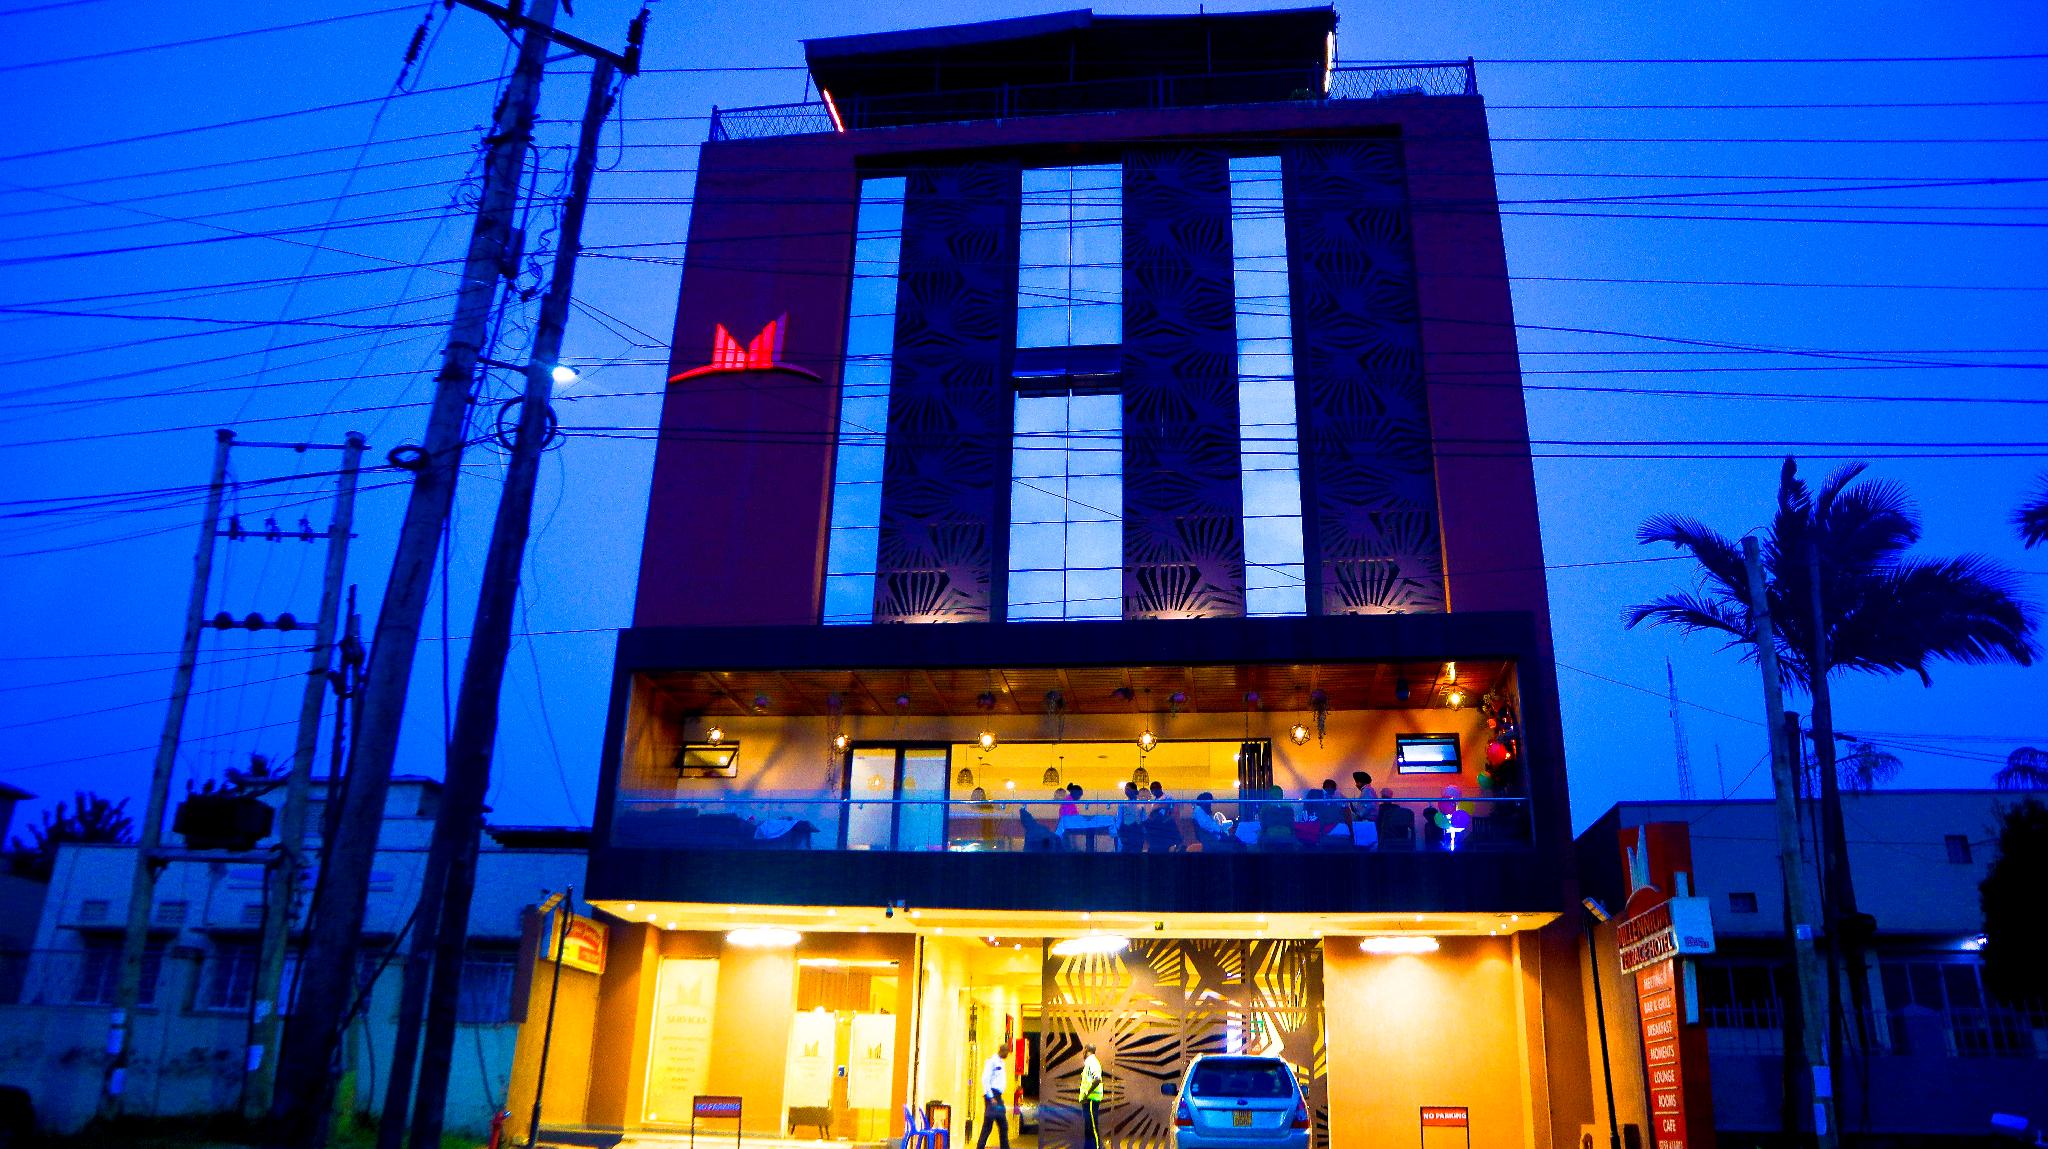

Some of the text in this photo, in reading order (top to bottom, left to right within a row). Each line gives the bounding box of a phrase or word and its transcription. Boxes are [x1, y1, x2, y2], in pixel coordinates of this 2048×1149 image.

[1617, 911, 1670, 948] MILLENNIUM
[1648, 931, 1673, 958] HOTEL
[1643, 1000, 1653, 1014] BAR
[1658, 996, 1672, 1011] GRILL
[1647, 1020, 1672, 1037] BREAKFAST
[1650, 1045, 1675, 1060] MOMENTS
[1653, 1069, 1675, 1083] LOUNGE
[1658, 1094, 1677, 1108] ROOMS
[1662, 1119, 1677, 1132] CAFE
